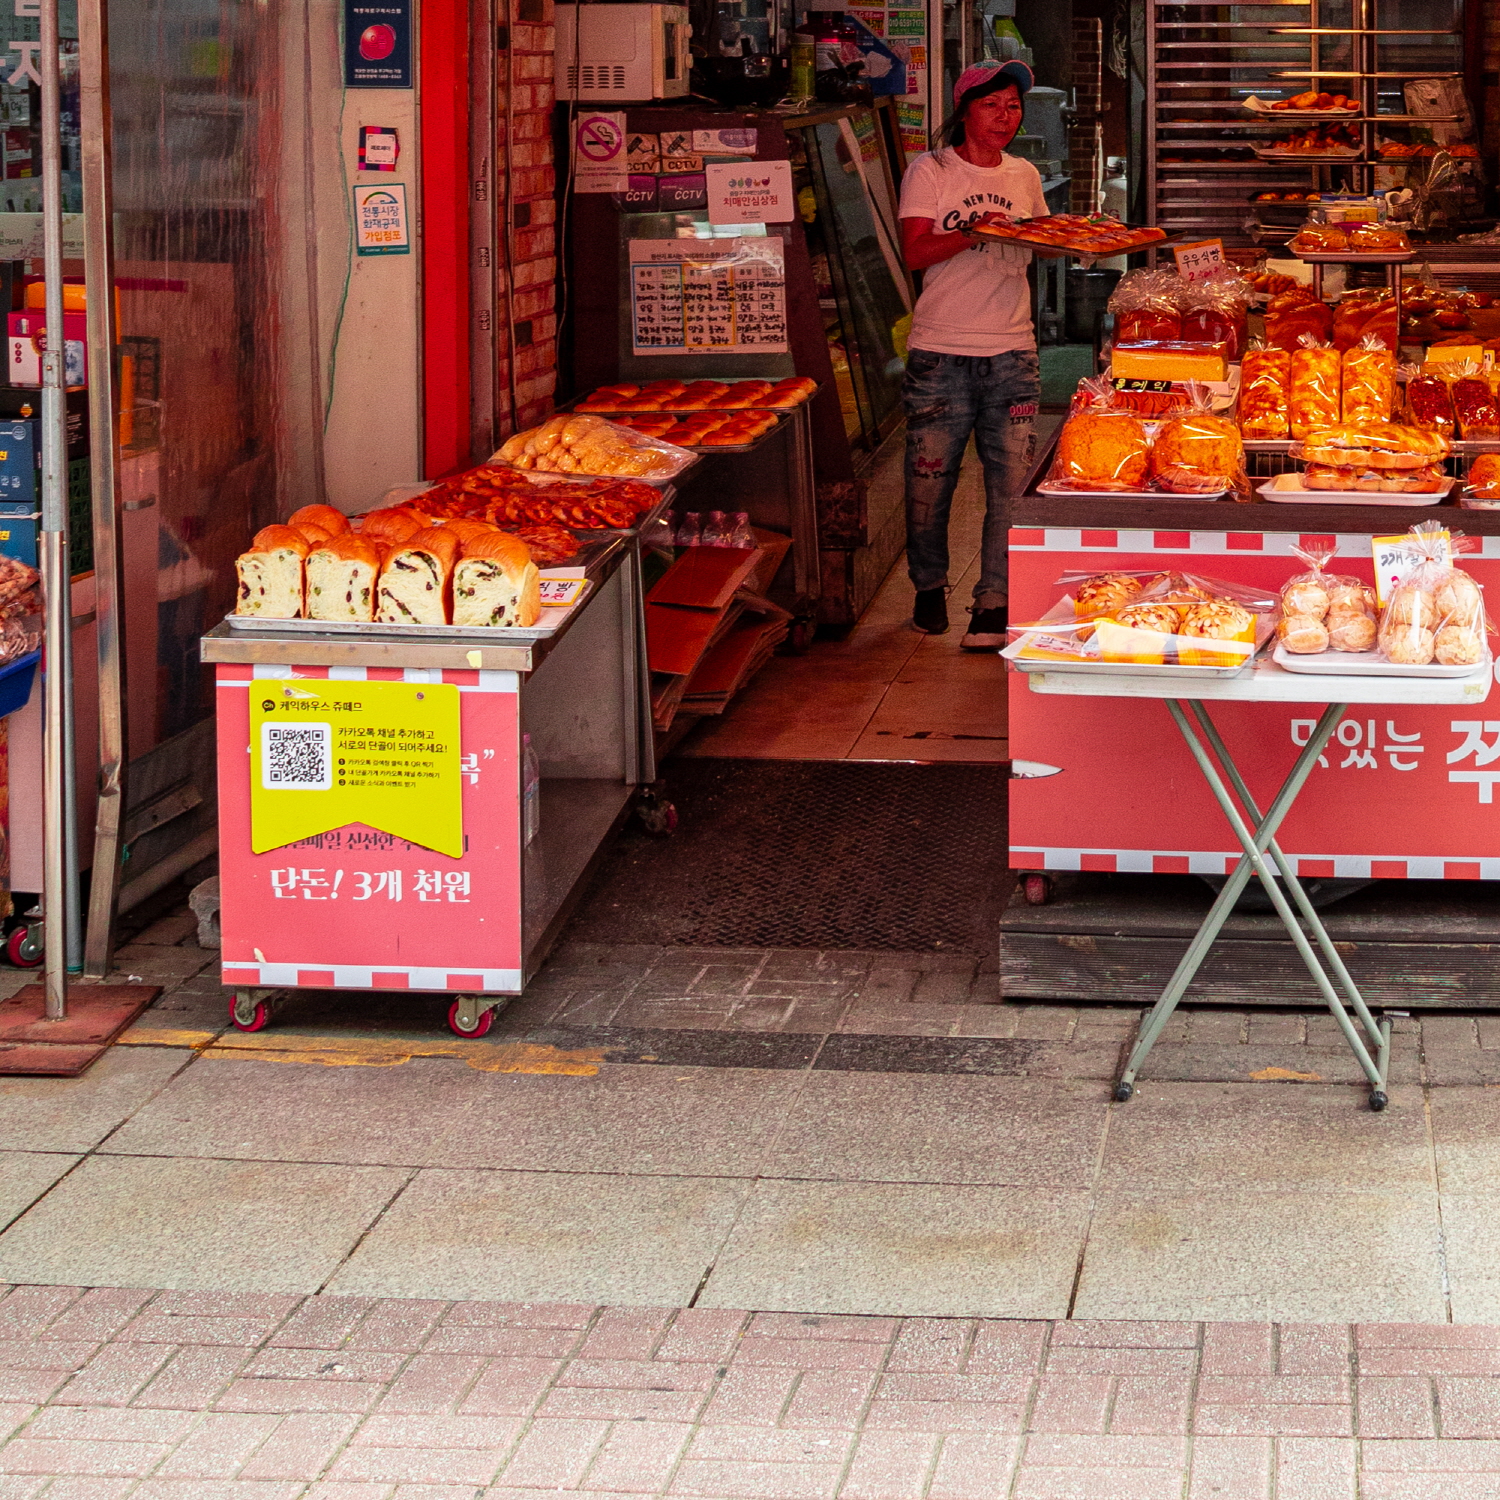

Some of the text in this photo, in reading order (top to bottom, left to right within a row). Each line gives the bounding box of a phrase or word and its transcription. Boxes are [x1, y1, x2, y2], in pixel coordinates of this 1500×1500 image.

[627, 163, 654, 172] CCTV
[668, 161, 698, 170] CCTV
[625, 191, 654, 202] CCTV
[674, 190, 703, 200] CCTV
[723, 194, 779, 207] 치매안심상점
[963, 192, 1014, 211] NEW YORK
[362, 206, 399, 217] 전통시장
[363, 218, 401, 229] 화재공제
[365, 230, 402, 242] 가입점포
[1182, 248, 1220, 269] 우유식빵
[279, 701, 331, 712] 케익하우스
[338, 727, 435, 740] 카카오톡 채널 추가하고
[338, 740, 448, 754] 서로의 단골이 되어주세요!
[271, 866, 471, 903] 단돈! 3개 천원
